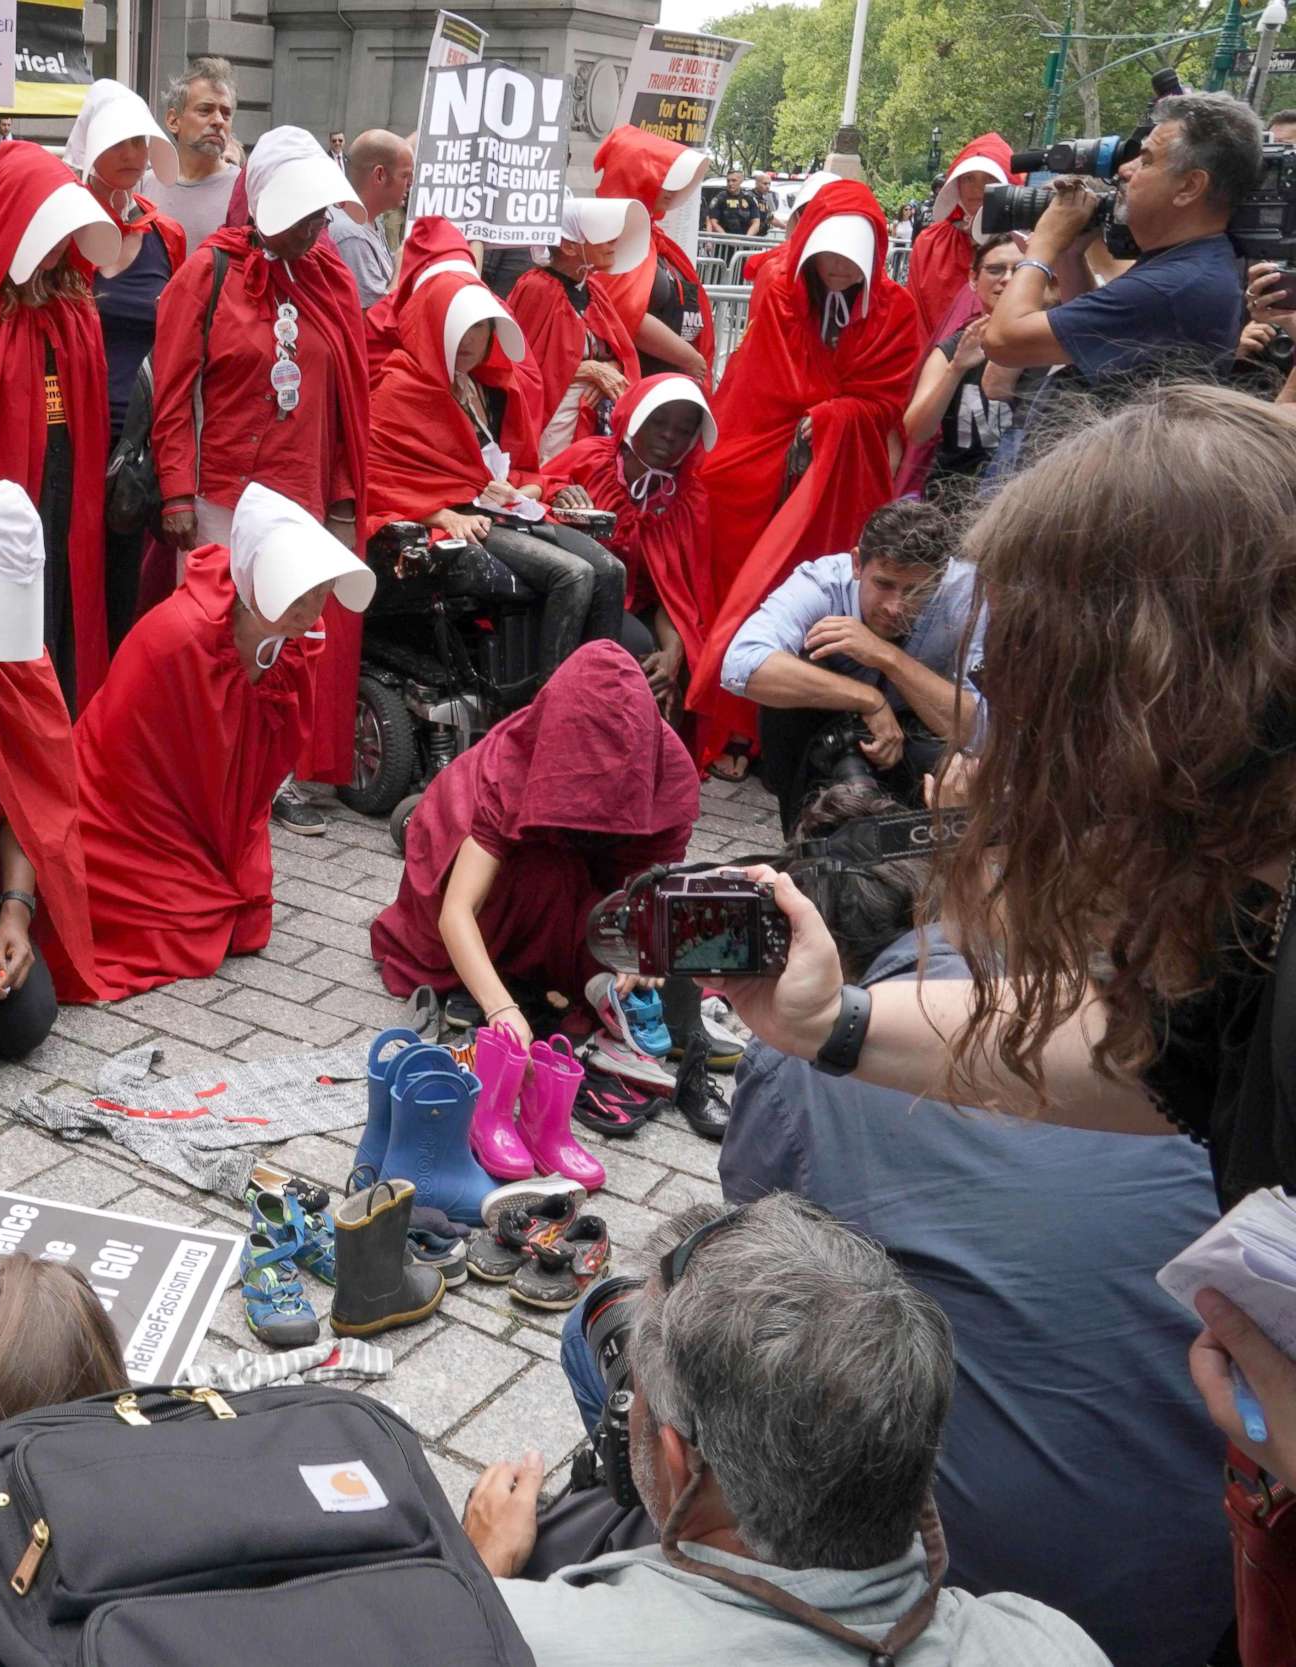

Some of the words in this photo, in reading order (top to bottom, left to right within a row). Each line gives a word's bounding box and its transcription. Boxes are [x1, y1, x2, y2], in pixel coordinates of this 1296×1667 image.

[429, 68, 563, 142] NO!
[658, 99, 676, 119] for
[436, 139, 472, 161] THE
[477, 135, 552, 169] TRUMP/
[419, 161, 482, 184] PENCE
[487, 161, 561, 190] REGIME
[415, 185, 499, 219] MUST
[506, 192, 561, 223] GO!
[90, 1239, 145, 1280] GO!
[126, 1248, 208, 1373] RefuseFascism.org
